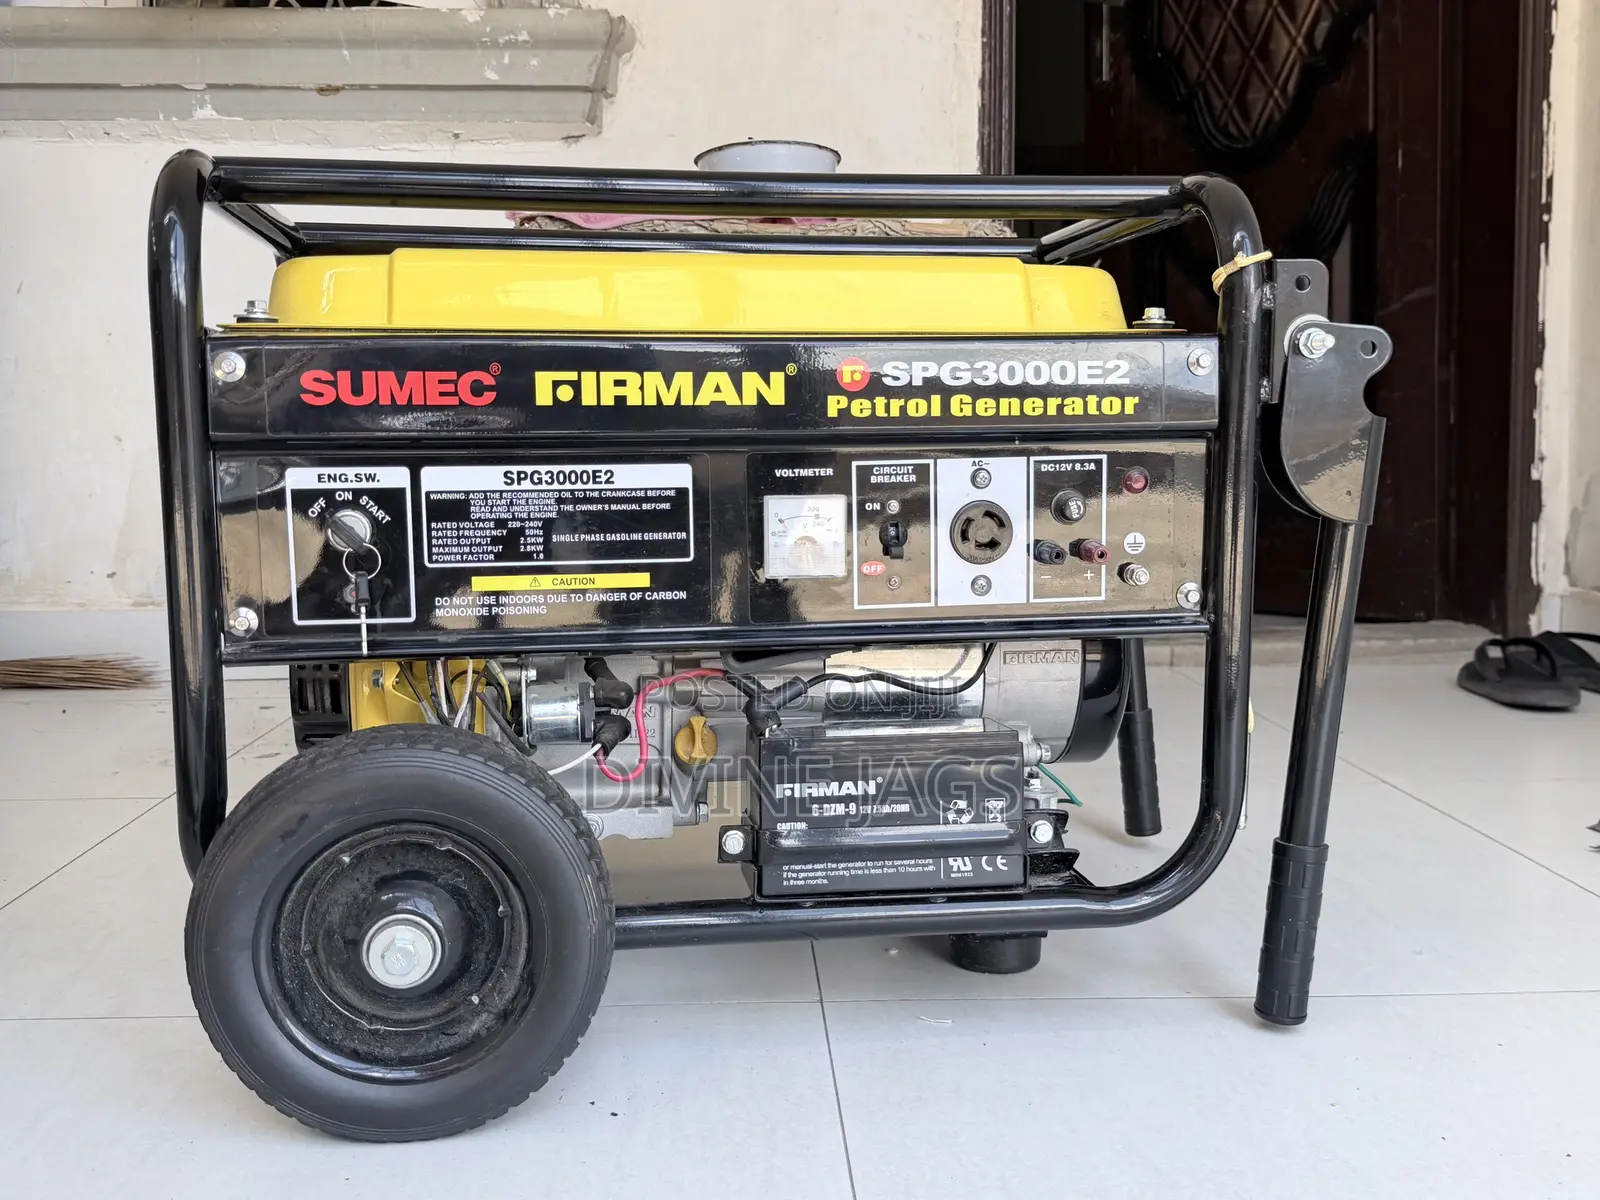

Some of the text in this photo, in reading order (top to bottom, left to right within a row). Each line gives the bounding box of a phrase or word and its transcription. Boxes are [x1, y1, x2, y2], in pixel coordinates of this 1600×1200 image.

[882, 360, 1130, 386] SPG3000E2
[827, 394, 1140, 418] Petrol Generator
[873, 466, 914, 475] CIRCUIT
[1041, 463, 1096, 472] DC12V 8.3A
[318, 473, 380, 483] ENG.SW.
[503, 470, 615, 486] SPG3000E2
[775, 468, 834, 478] VOLTMETER
[870, 474, 916, 484] BREAKER
[336, 491, 352, 501] ON
[308, 497, 328, 518] OFF
[359, 496, 391, 524] START
[865, 503, 881, 511] ON
[1068, 500, 1080, 518] FUSE
[552, 532, 687, 542] SINGLE PHASE GASOLINE GENERATOR
[432, 546, 470, 554] MAXIMUM
[863, 565, 883, 573] OFF
[552, 577, 596, 586] CAUTION
[435, 590, 687, 606] DO NOT USE INDOORS DUE TO DANGER OF CARBON
[435, 605, 547, 617] MONOXIDE POISONING
[812, 803, 857, 816] 6-DZM-9
[838, 861, 866, 869] generator
[798, 871, 826, 879] generator
